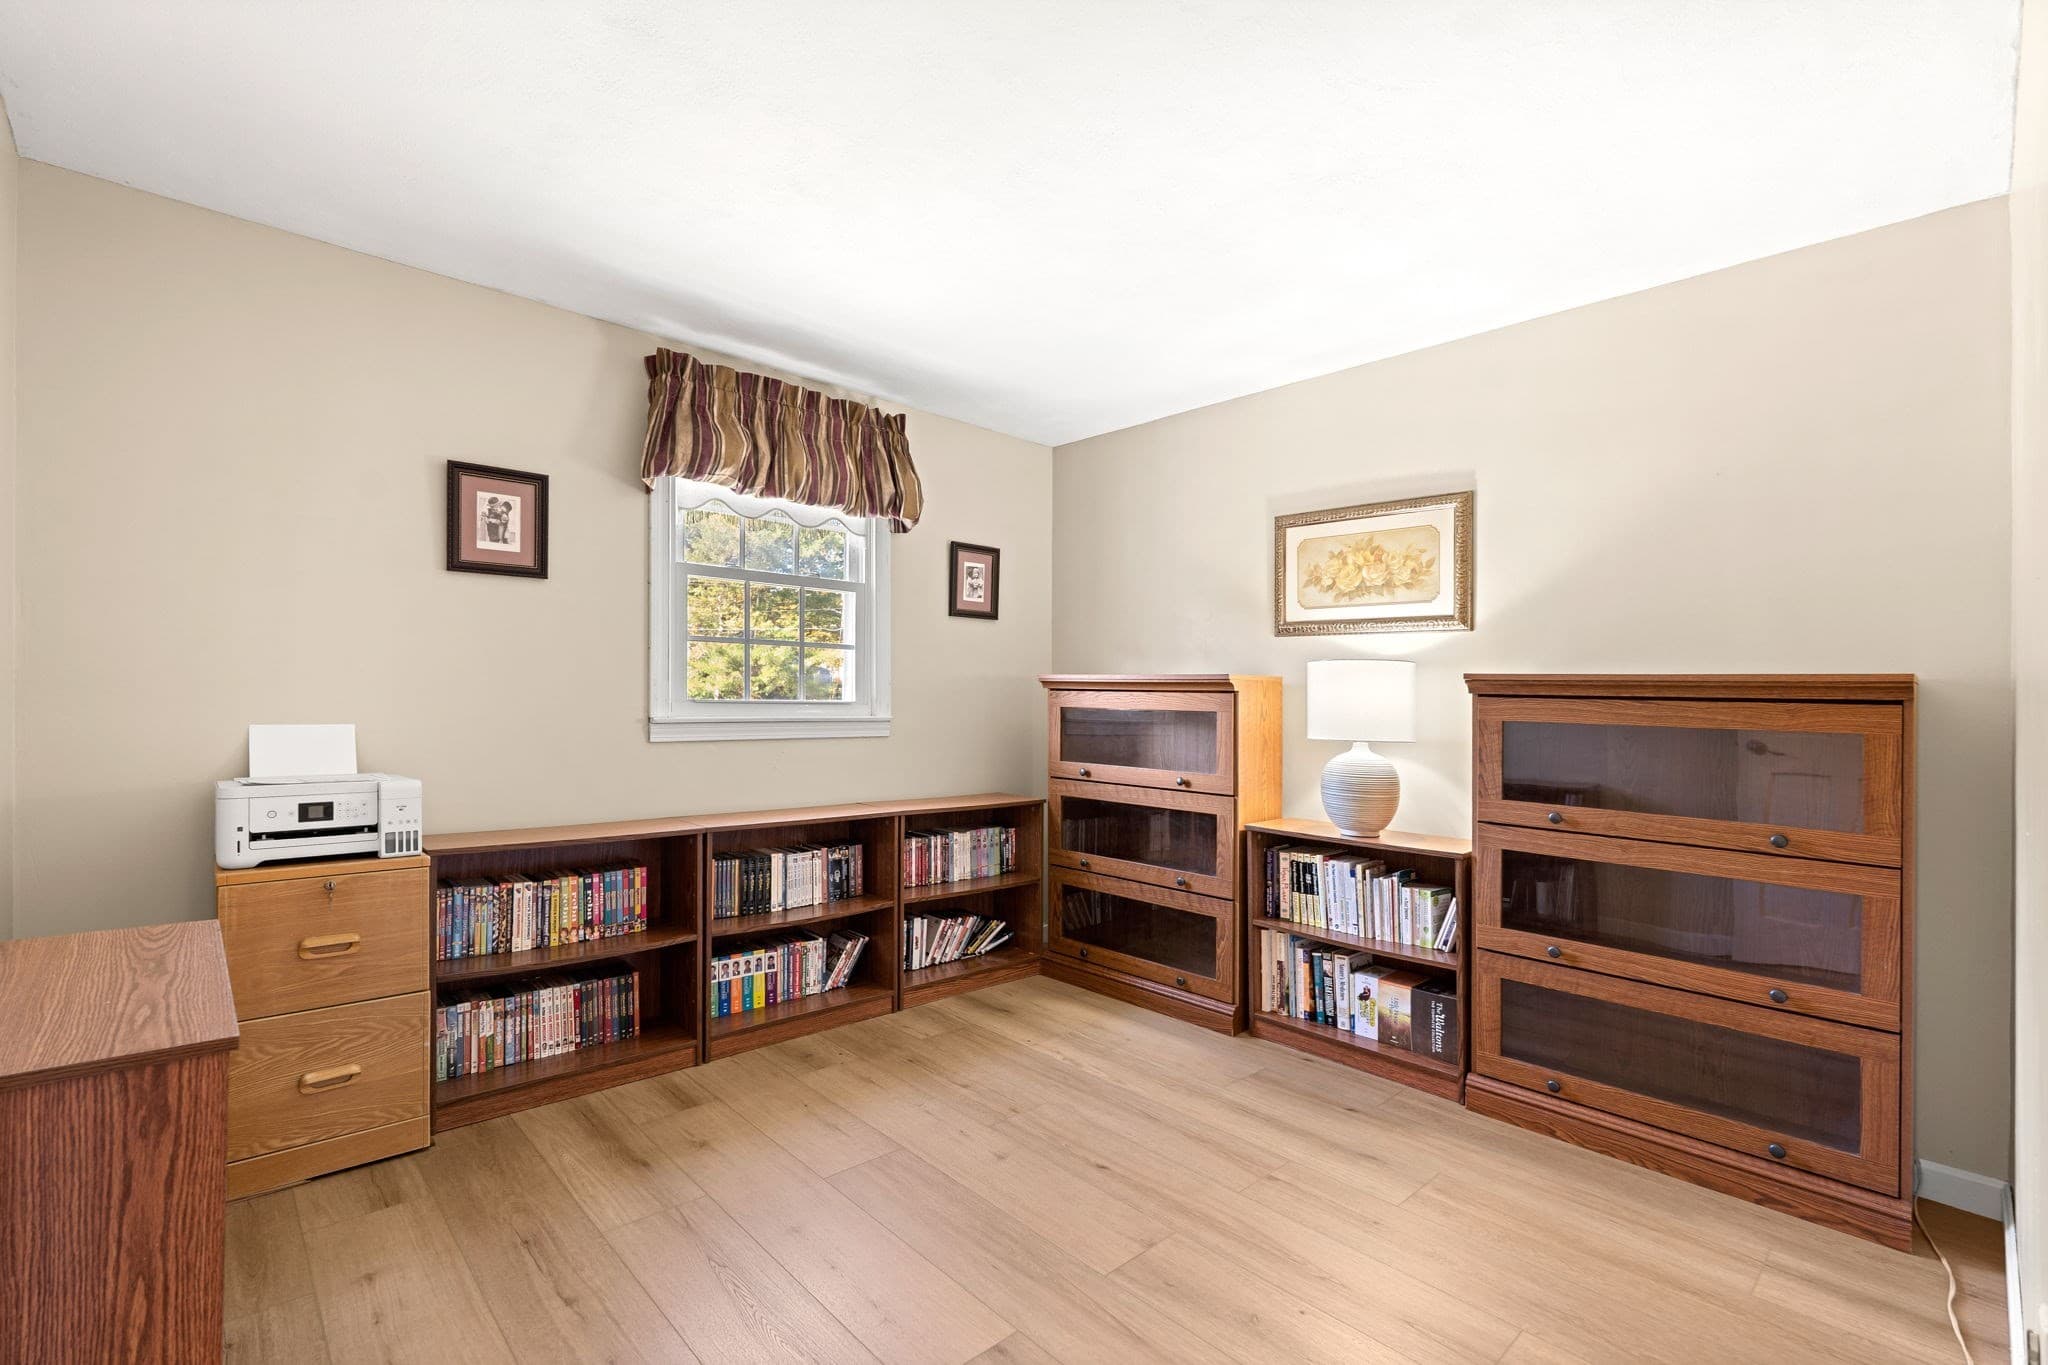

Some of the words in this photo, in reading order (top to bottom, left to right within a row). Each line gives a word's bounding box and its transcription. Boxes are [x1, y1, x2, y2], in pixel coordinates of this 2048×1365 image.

[1323, 976, 1334, 1017] BREAKTHROUGH
[1435, 1002, 1443, 1014] The
[1435, 1014, 1446, 1053] Waltons
